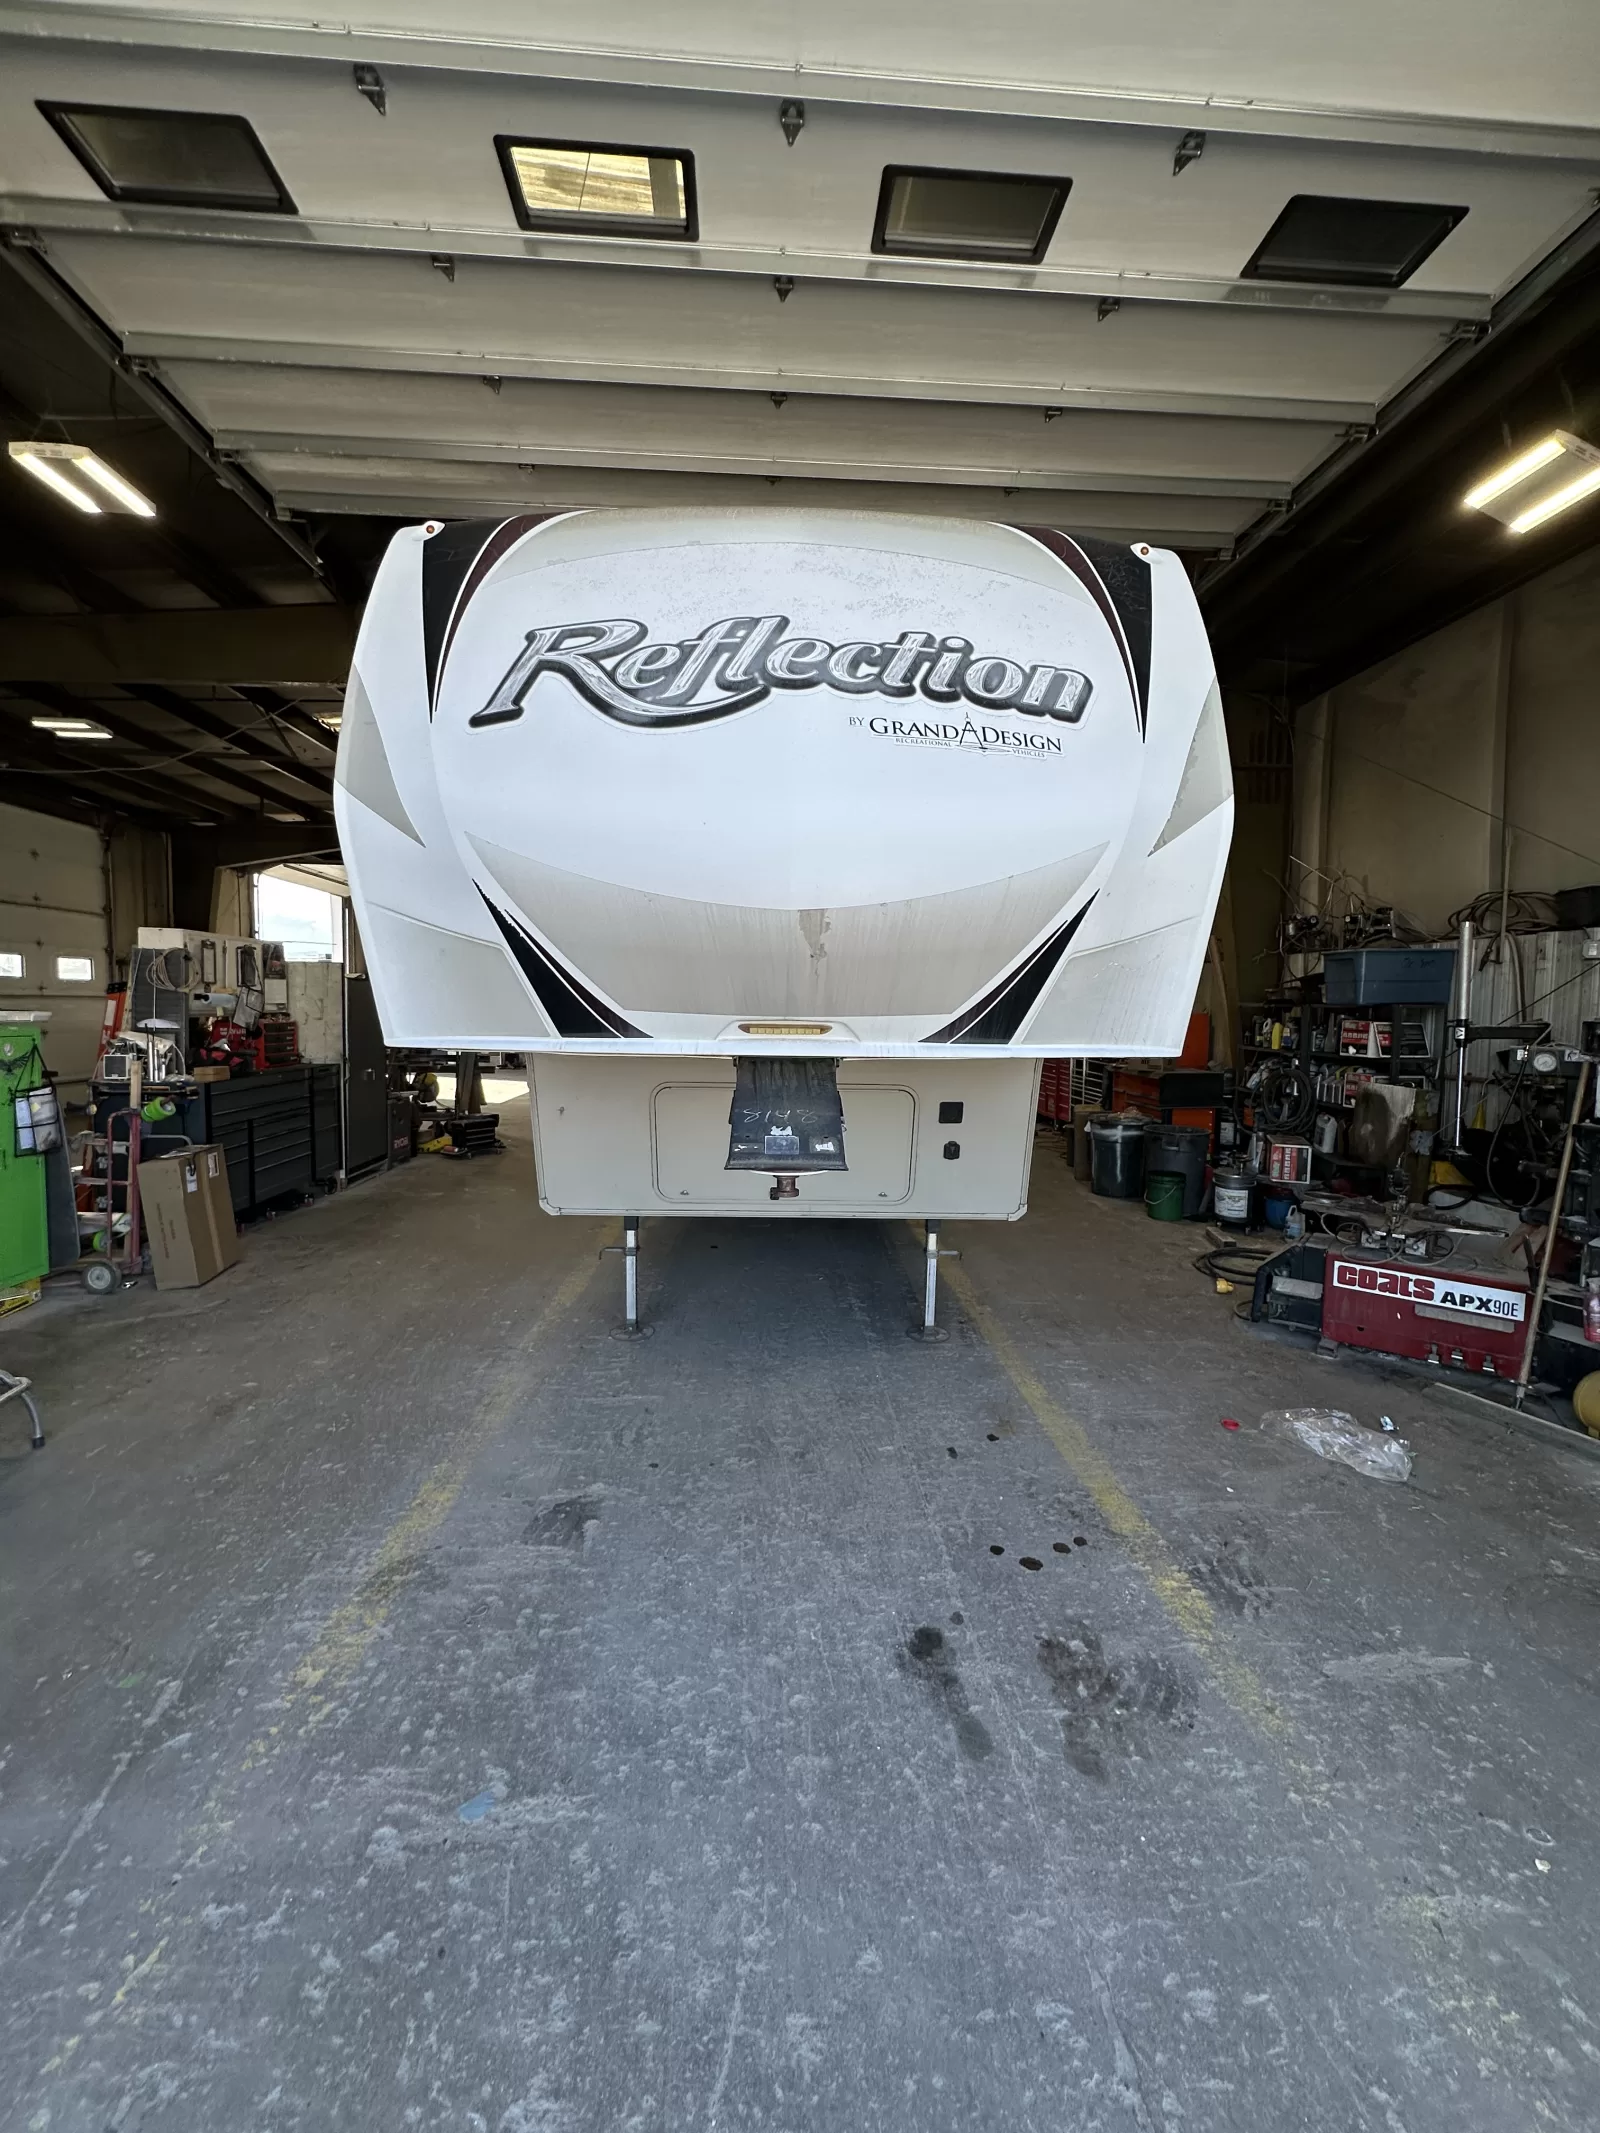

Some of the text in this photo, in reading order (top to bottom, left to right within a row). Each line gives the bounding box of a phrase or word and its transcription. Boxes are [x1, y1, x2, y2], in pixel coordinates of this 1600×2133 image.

[468, 615, 1095, 728] Reflection
[849, 716, 865, 726] BY
[895, 738, 1045, 758] RECREATIONAL VEHICLES
[743, 1108, 818, 1124] 8148
